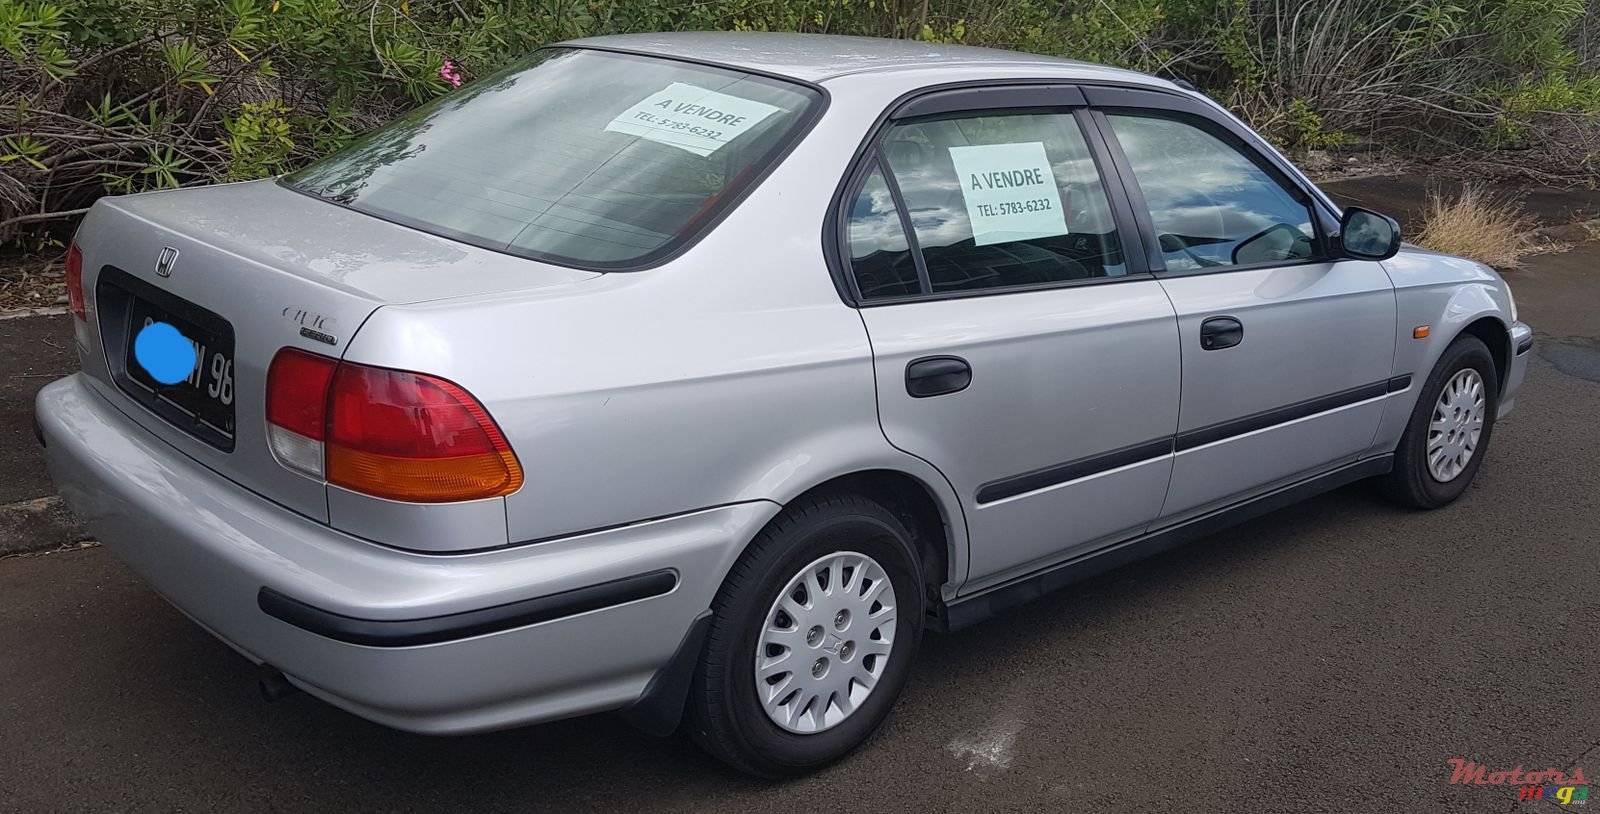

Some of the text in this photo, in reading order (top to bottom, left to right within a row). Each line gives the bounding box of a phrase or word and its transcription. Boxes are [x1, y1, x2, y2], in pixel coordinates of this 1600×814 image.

[634, 111, 722, 140] TEL: 5783-6232
[654, 99, 747, 127] A VENDRE
[971, 168, 1044, 190] A VENDRE
[977, 198, 1052, 217] TEL: 5783-6232
